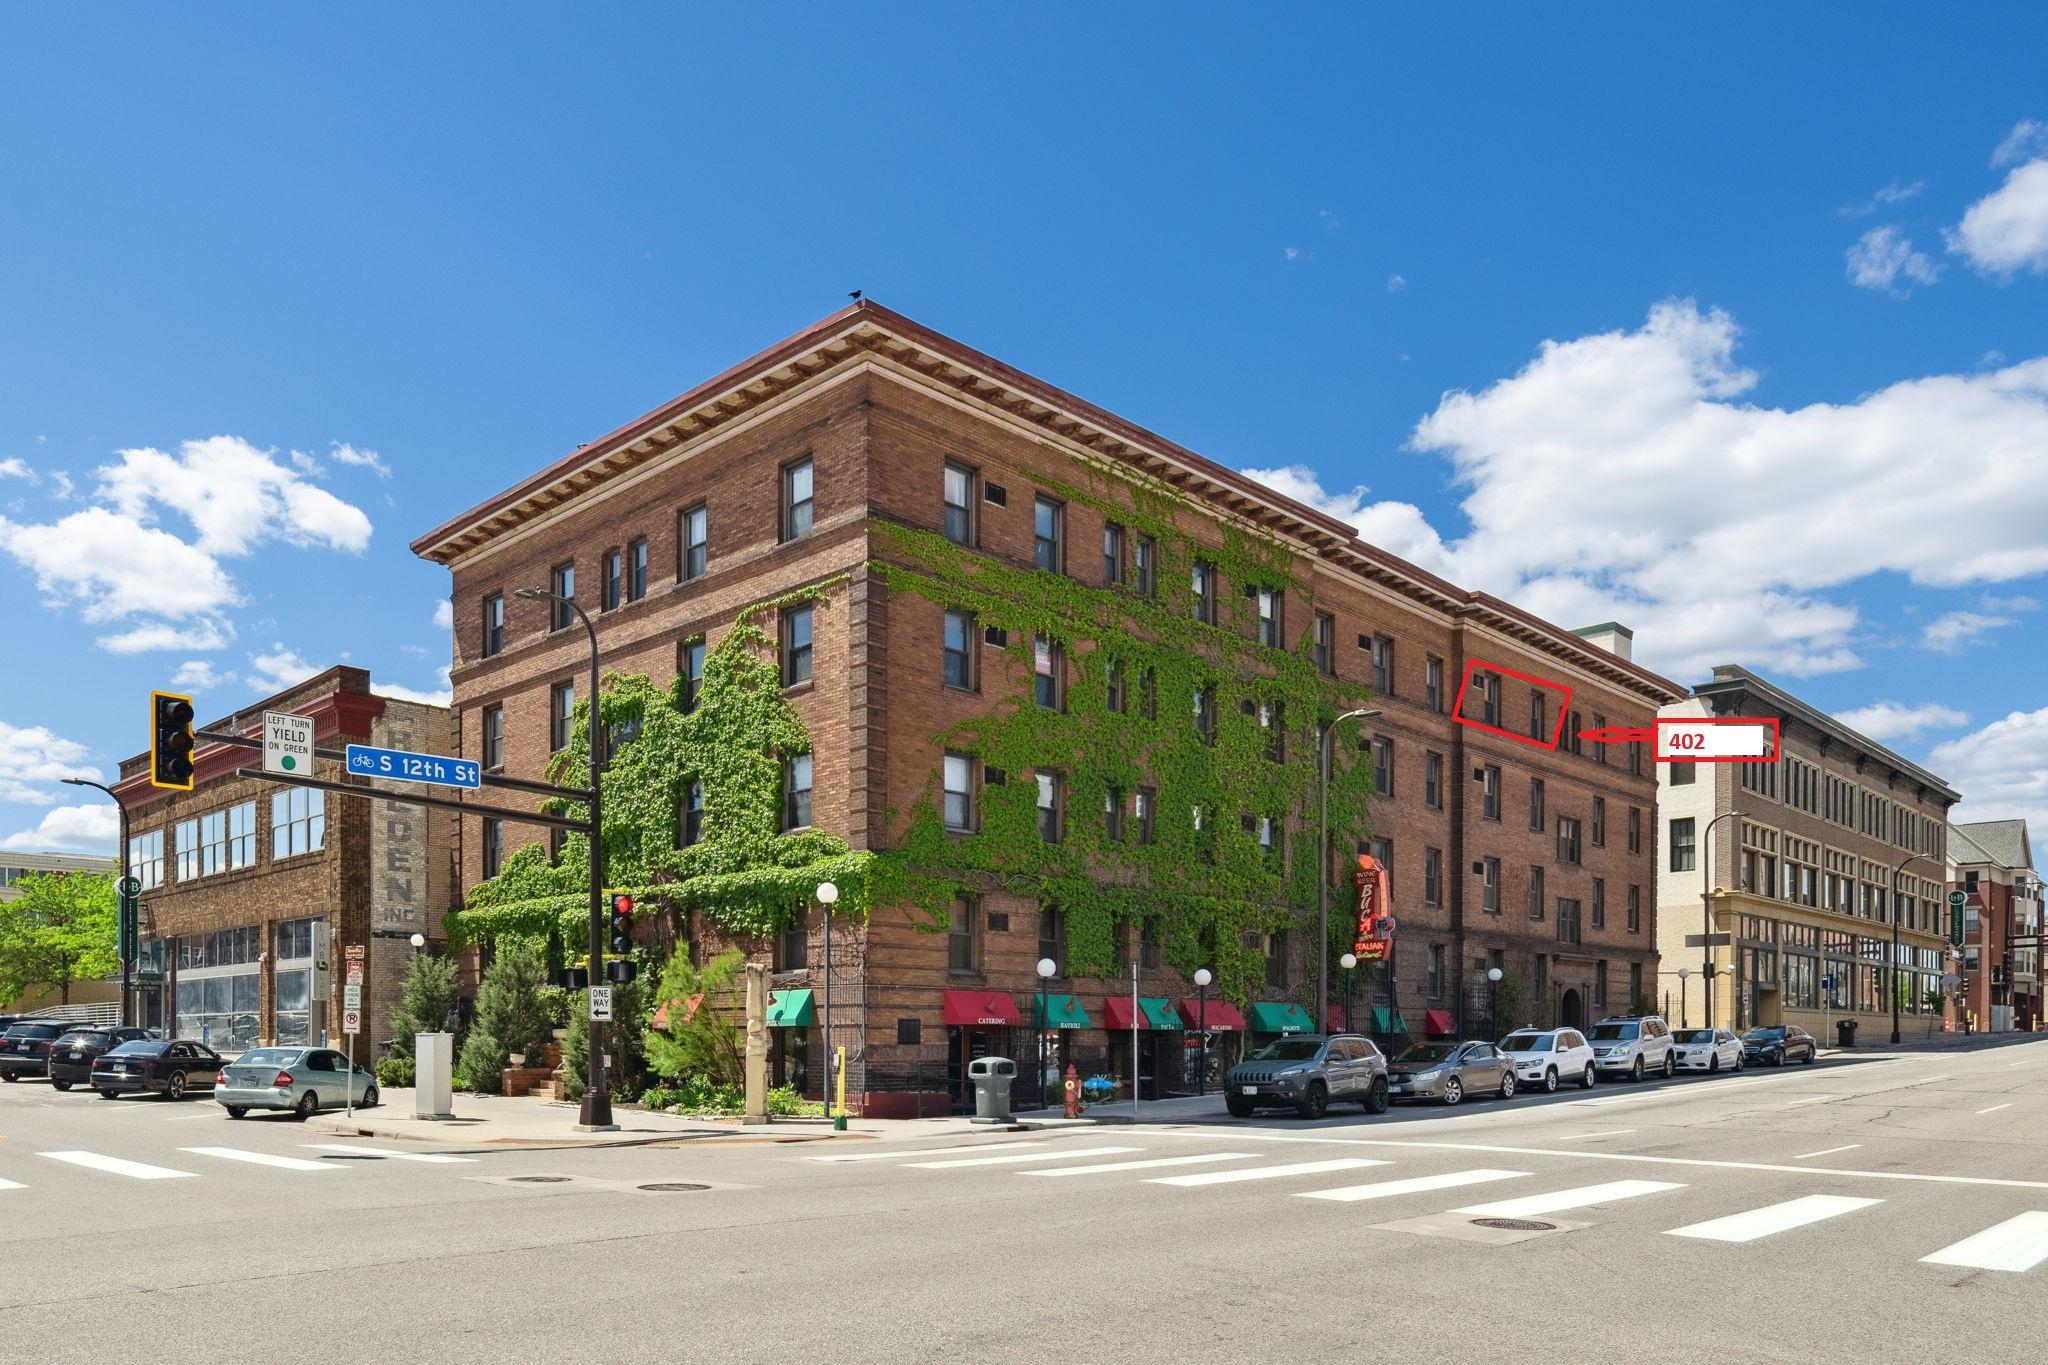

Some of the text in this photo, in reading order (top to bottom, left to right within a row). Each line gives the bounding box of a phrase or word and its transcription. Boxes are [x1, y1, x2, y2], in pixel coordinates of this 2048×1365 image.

[268, 715, 310, 729] LEFT TURN
[273, 727, 305, 743] YIELD
[268, 741, 308, 754] ON GREEN
[380, 755, 476, 783] S 12th St
[1355, 942, 1384, 950] ITALIAN
[593, 990, 609, 998] ONE
[593, 999, 609, 1007] WAY
